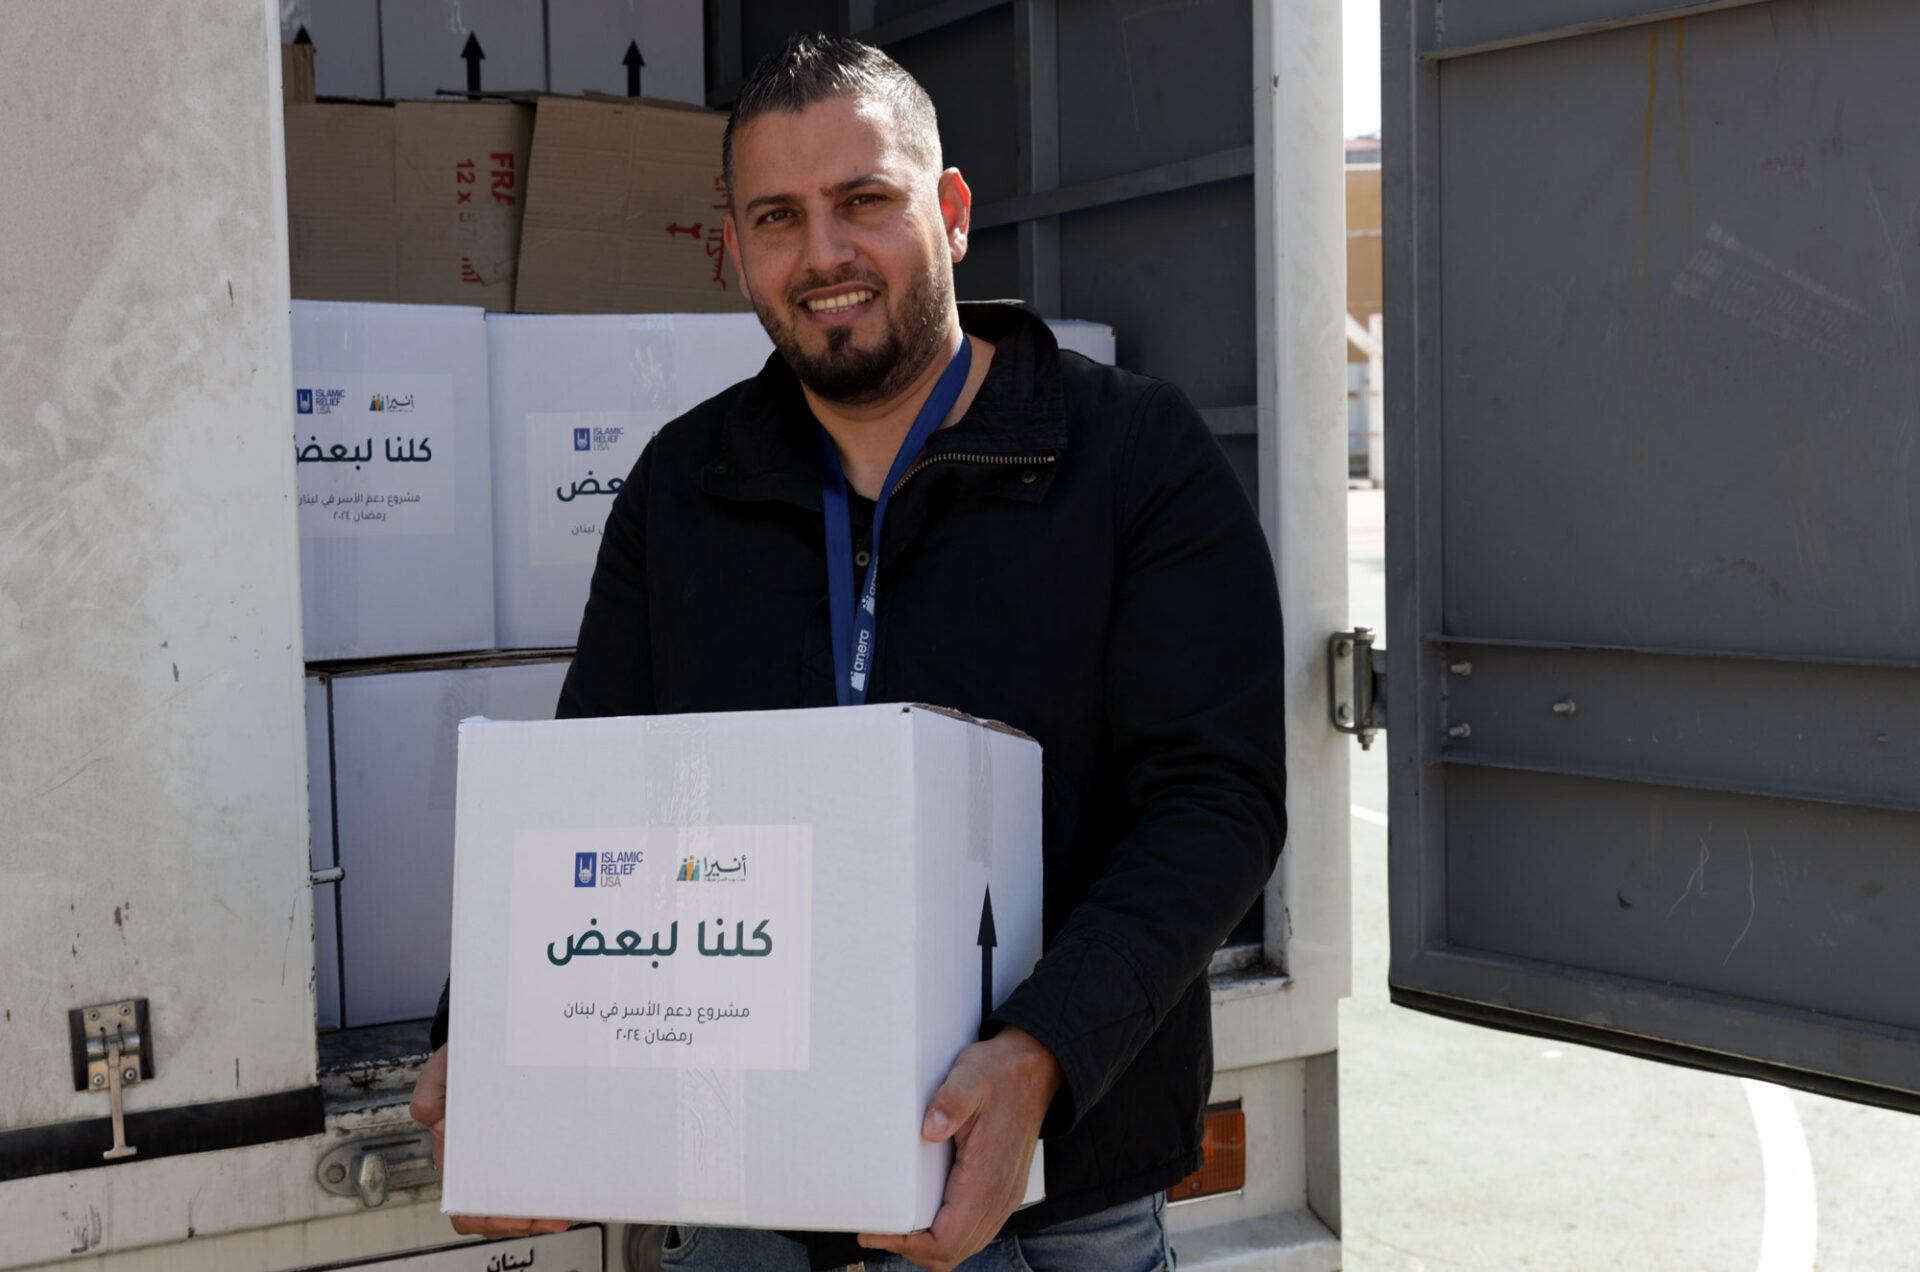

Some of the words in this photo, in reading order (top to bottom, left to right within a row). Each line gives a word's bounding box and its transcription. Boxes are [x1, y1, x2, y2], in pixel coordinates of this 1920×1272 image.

[456, 158, 476, 184] 12
[490, 152, 516, 206] FRA
[315, 389, 345, 398] ISLAMIC
[315, 398, 341, 406] RELIEF
[316, 406, 332, 414] USA
[593, 427, 624, 435] ISLAMIC
[593, 435, 619, 443] RELIEF
[385, 436, 432, 463] كلنا
[593, 443, 609, 451] USA
[321, 494, 335, 508] في
[365, 495, 385, 507] دعم
[387, 492, 421, 507] مشروع
[353, 511, 386, 522] رمضان
[571, 524, 595, 535] لبنان
[854, 629, 870, 671] anera
[601, 851, 643, 863] ISLAMIC
[600, 863, 636, 876] RELIEF
[703, 854, 747, 878] أنيرا
[600, 876, 622, 887] USA
[547, 918, 678, 969] لبعض
[698, 918, 773, 957] كلنا
[563, 1002, 595, 1019] لبنان
[600, 1003, 619, 1022] في
[621, 1001, 660, 1019] الأسر
[663, 1006, 692, 1021] دعم
[696, 1002, 750, 1023] مشروع
[616, 1028, 640, 1041] ٢٠٢٤
[644, 1028, 693, 1045] رمضان
[486, 1248, 534, 1272] لبنان
